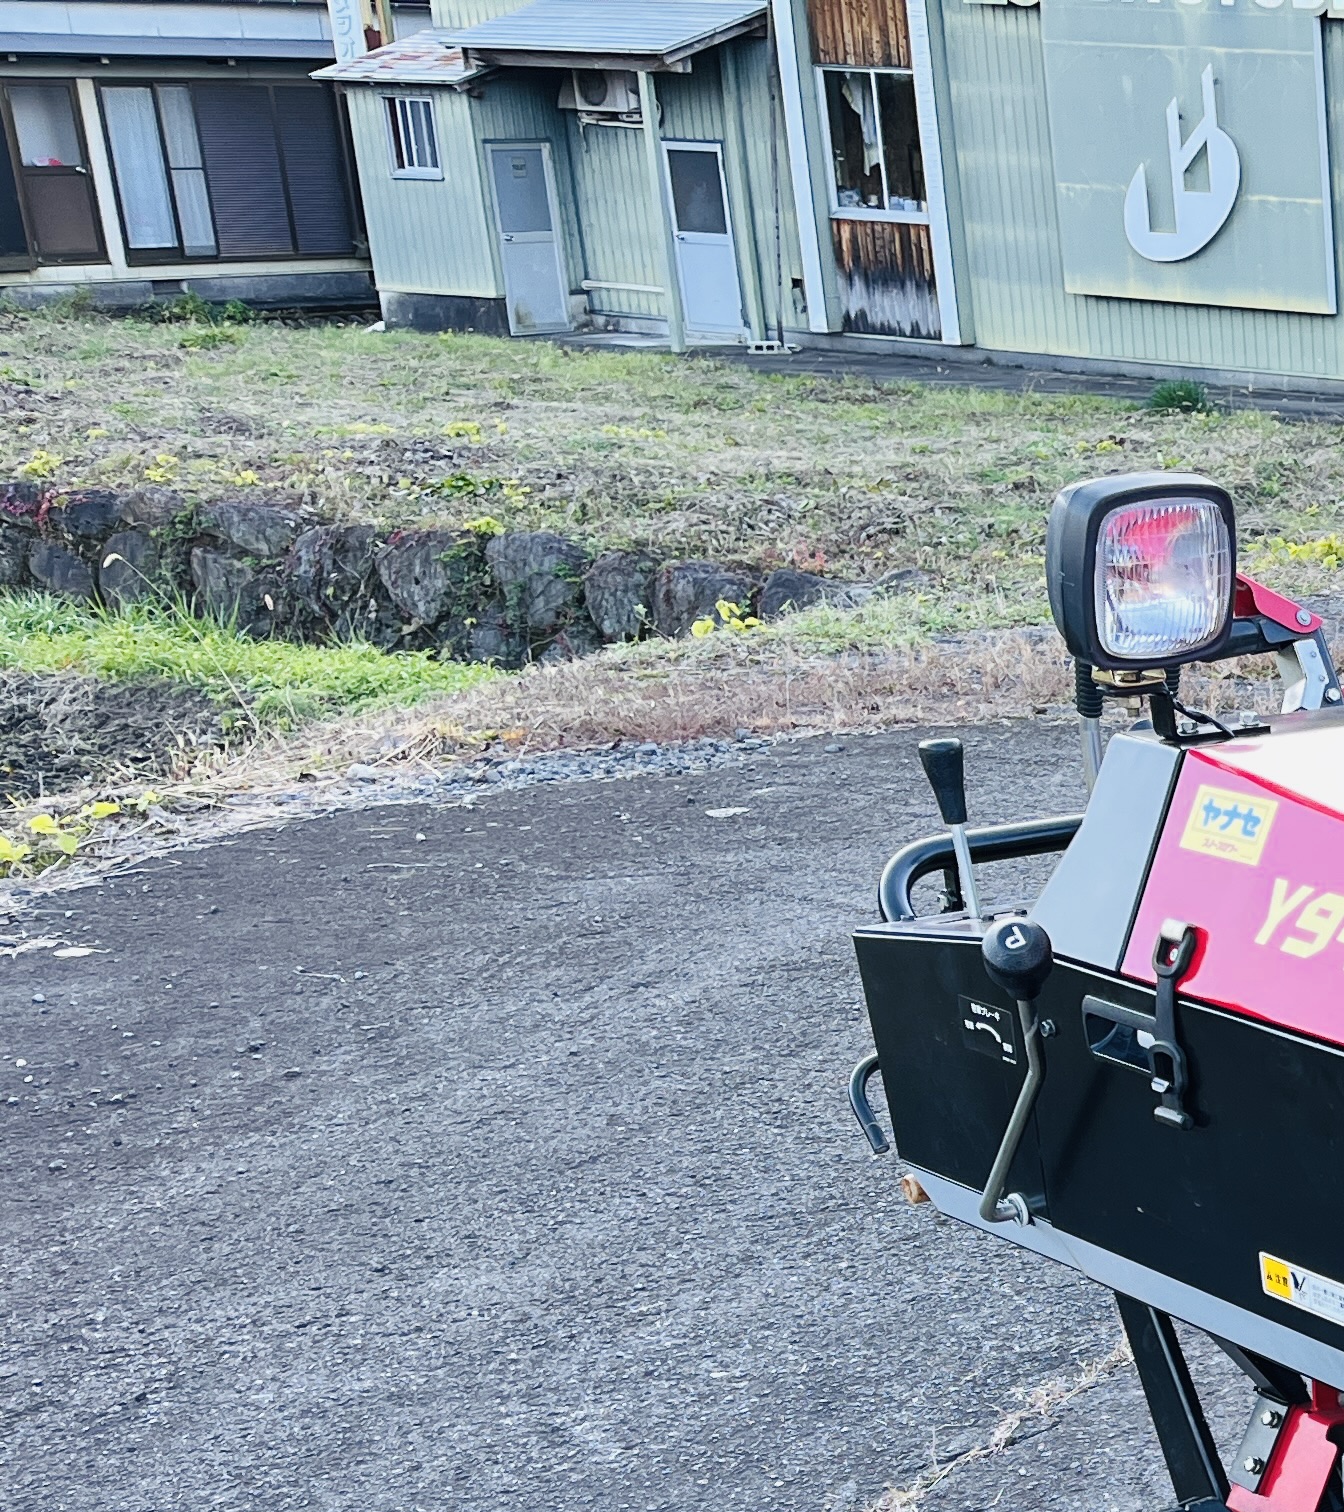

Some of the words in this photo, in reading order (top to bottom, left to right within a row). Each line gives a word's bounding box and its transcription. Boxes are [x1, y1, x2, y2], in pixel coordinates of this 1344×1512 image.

[1202, 798, 1262, 838] ヤナセ
[1004, 925, 1027, 949] P
